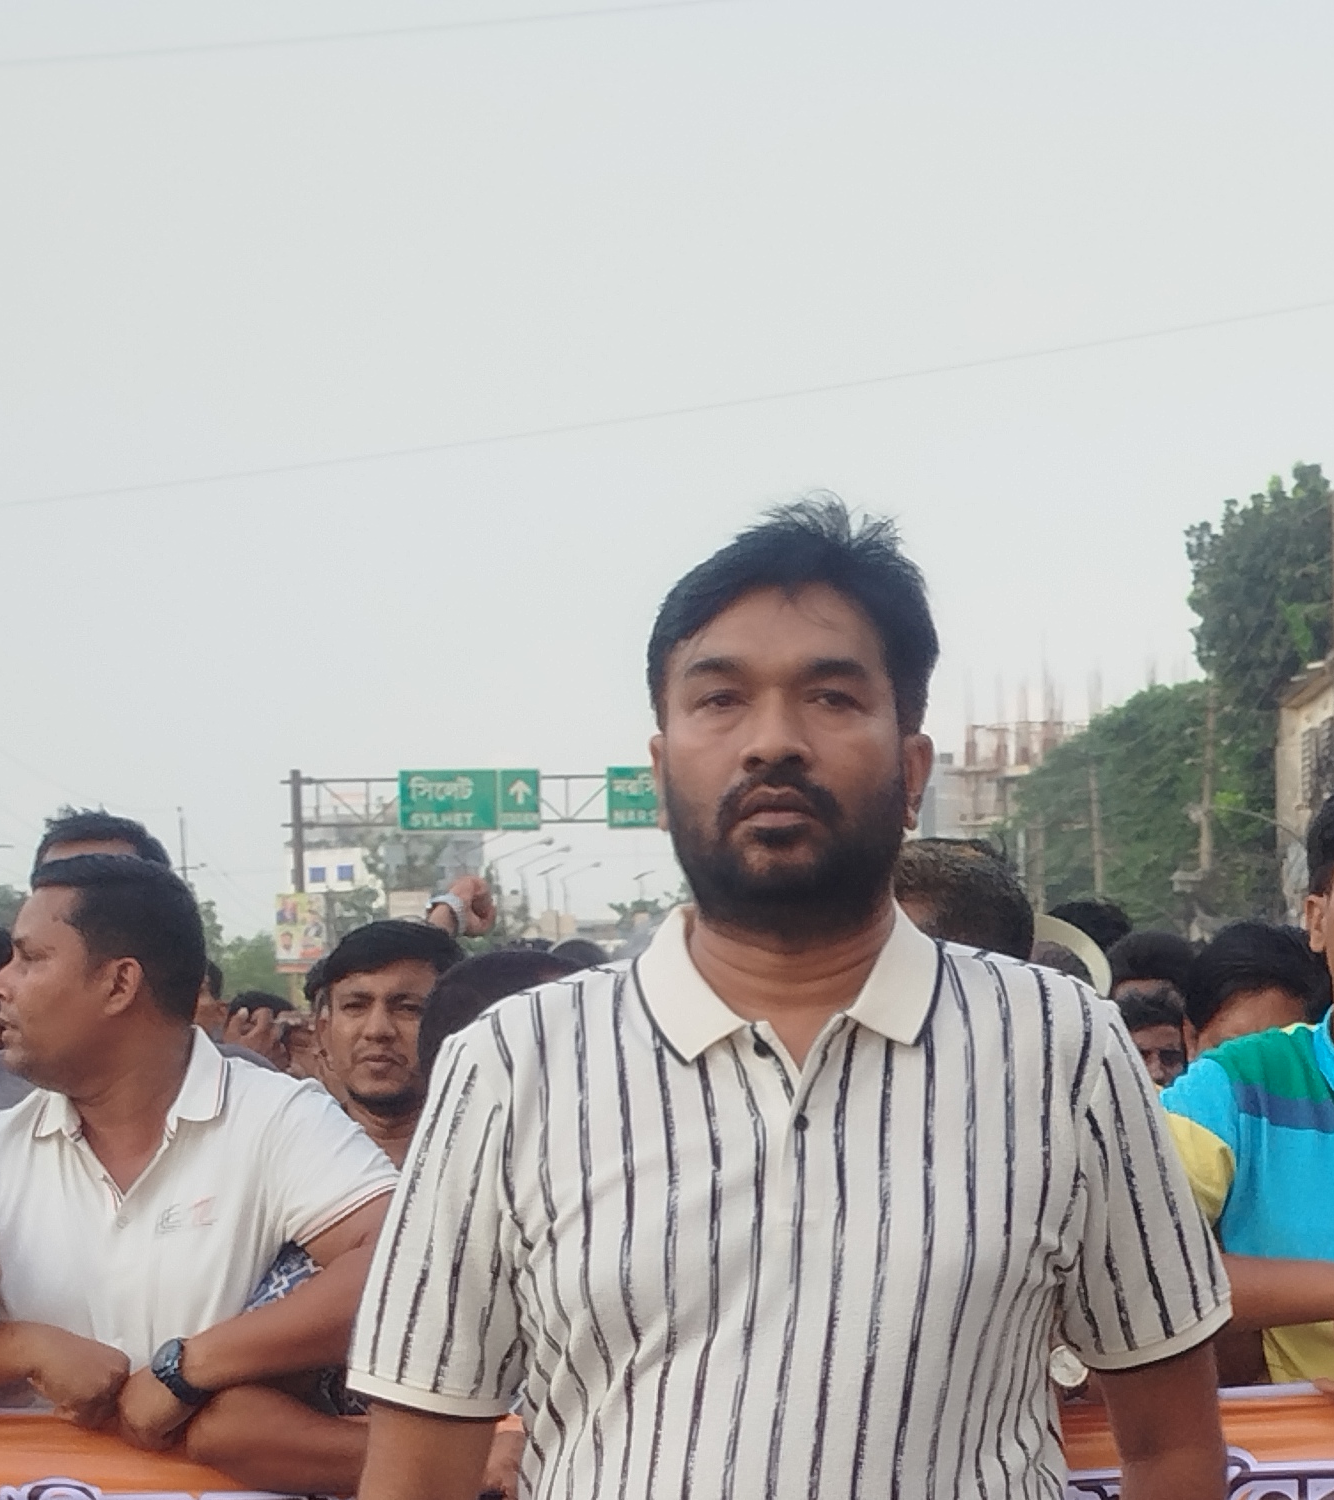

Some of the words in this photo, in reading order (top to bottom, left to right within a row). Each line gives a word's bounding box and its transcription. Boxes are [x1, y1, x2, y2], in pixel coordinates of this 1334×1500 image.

[409, 776, 474, 801] সিলেট
[409, 811, 475, 827] SYLHET
[612, 809, 657, 824] NARS
